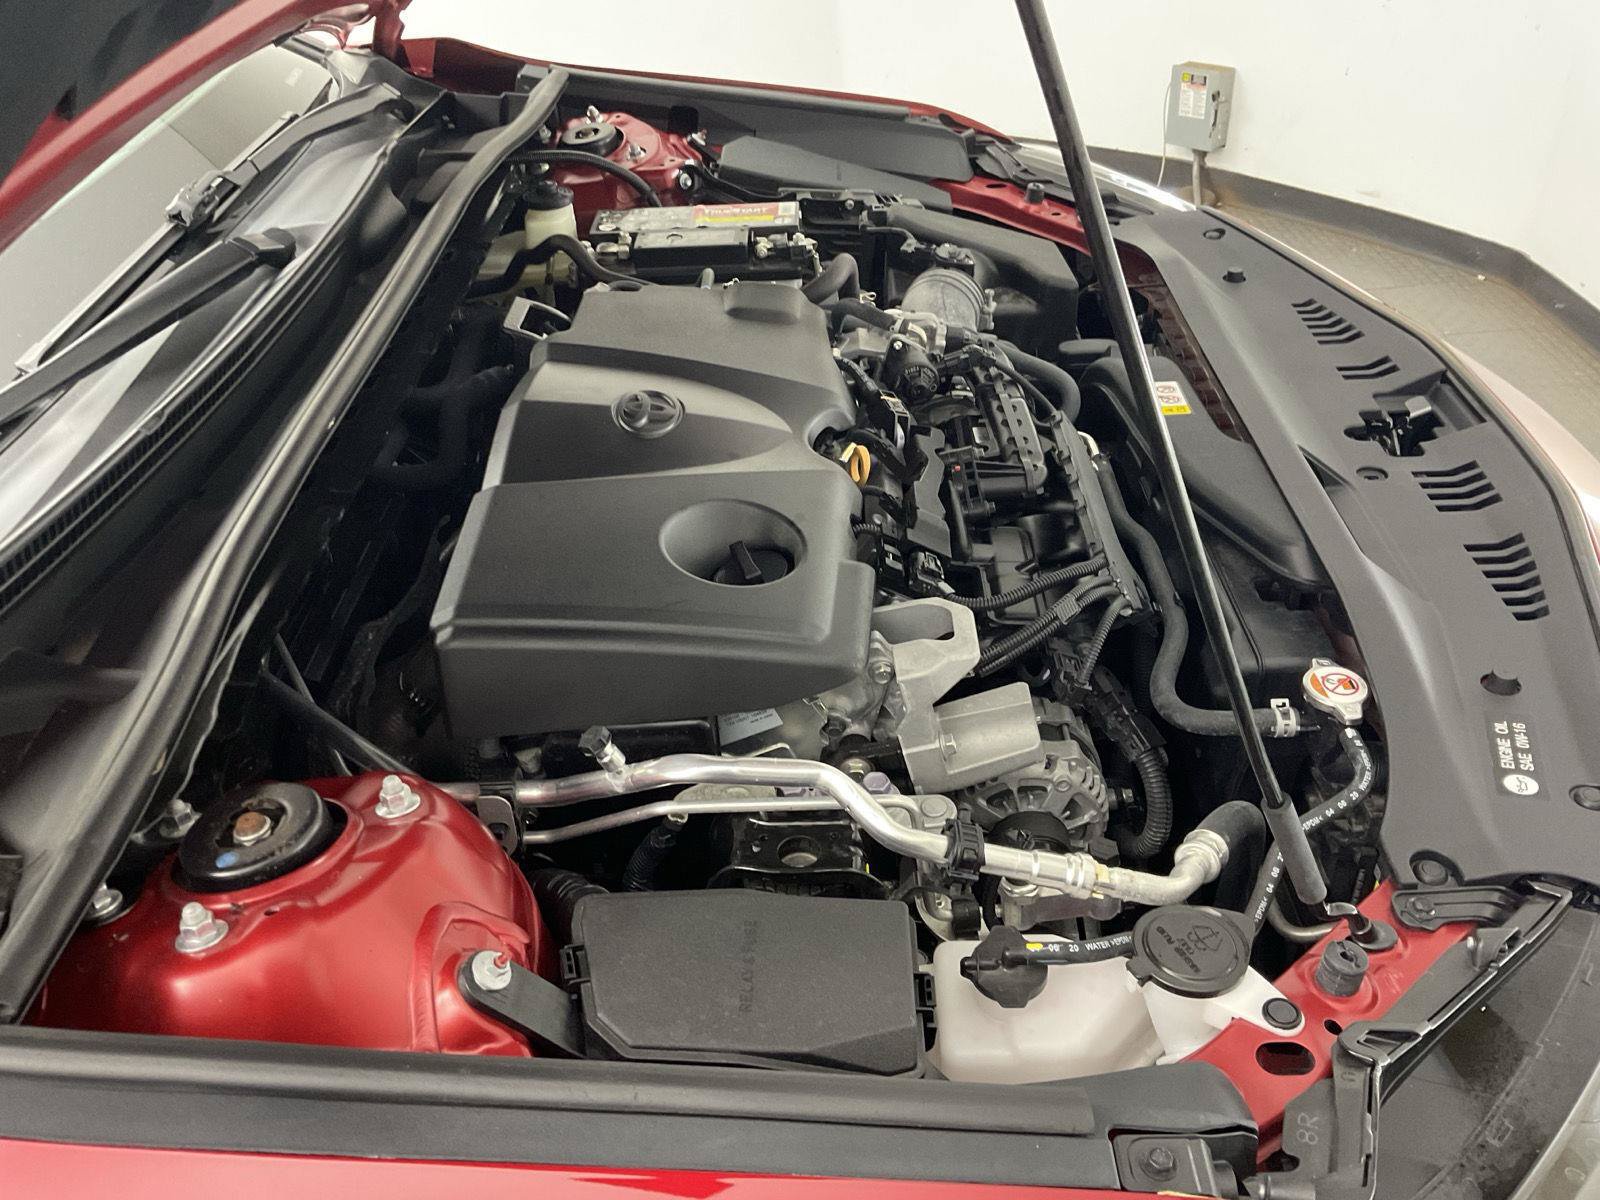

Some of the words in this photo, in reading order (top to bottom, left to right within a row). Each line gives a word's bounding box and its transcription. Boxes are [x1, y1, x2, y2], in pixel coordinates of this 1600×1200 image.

[1494, 720, 1508, 735] OIL
[1512, 722, 1530, 749] 0W-16
[1496, 738, 1515, 769] ENGINE
[1517, 752, 1534, 772] SAE
[1359, 771, 1372, 791] WATER
[1068, 943, 1080, 952] 20
[1085, 940, 1111, 951] WATER
[1296, 1112, 1319, 1145] 8R
